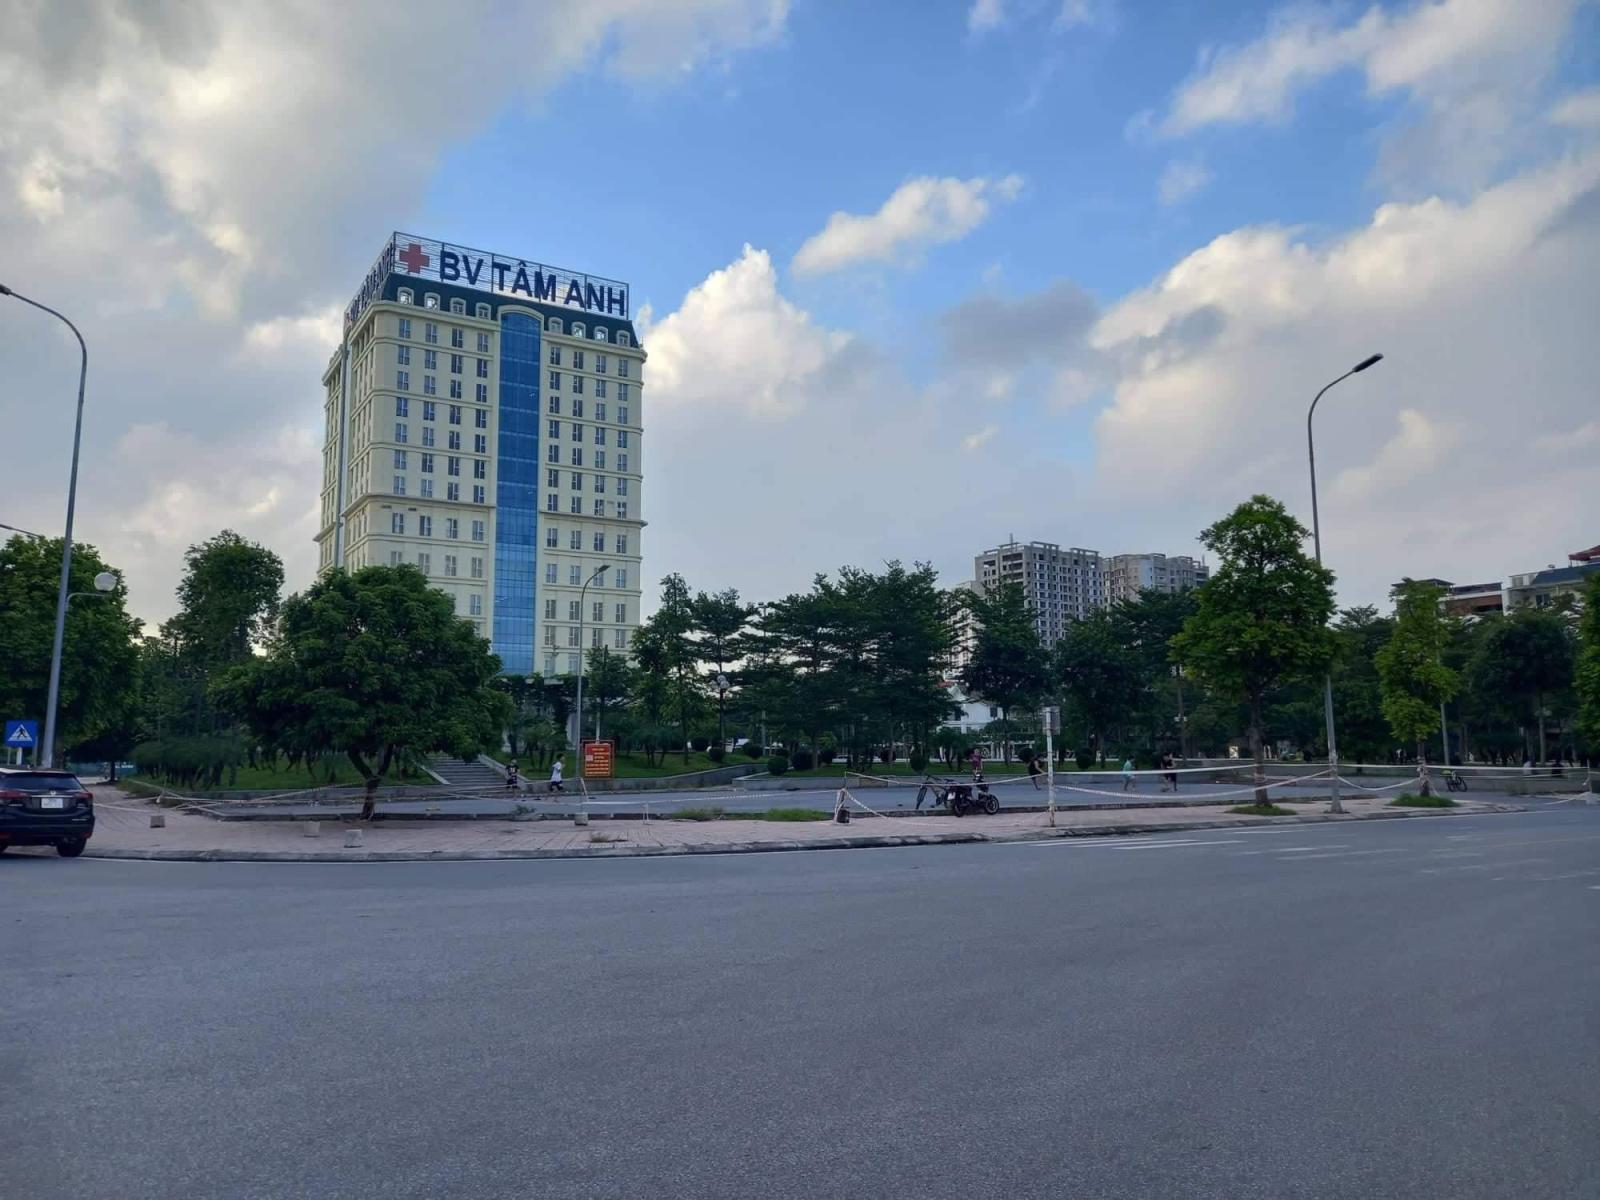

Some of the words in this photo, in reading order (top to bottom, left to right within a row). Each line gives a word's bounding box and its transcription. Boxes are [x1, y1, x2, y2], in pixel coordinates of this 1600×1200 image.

[440, 249, 484, 285] BV
[492, 260, 556, 302] TÂM
[564, 279, 625, 316] ANH
